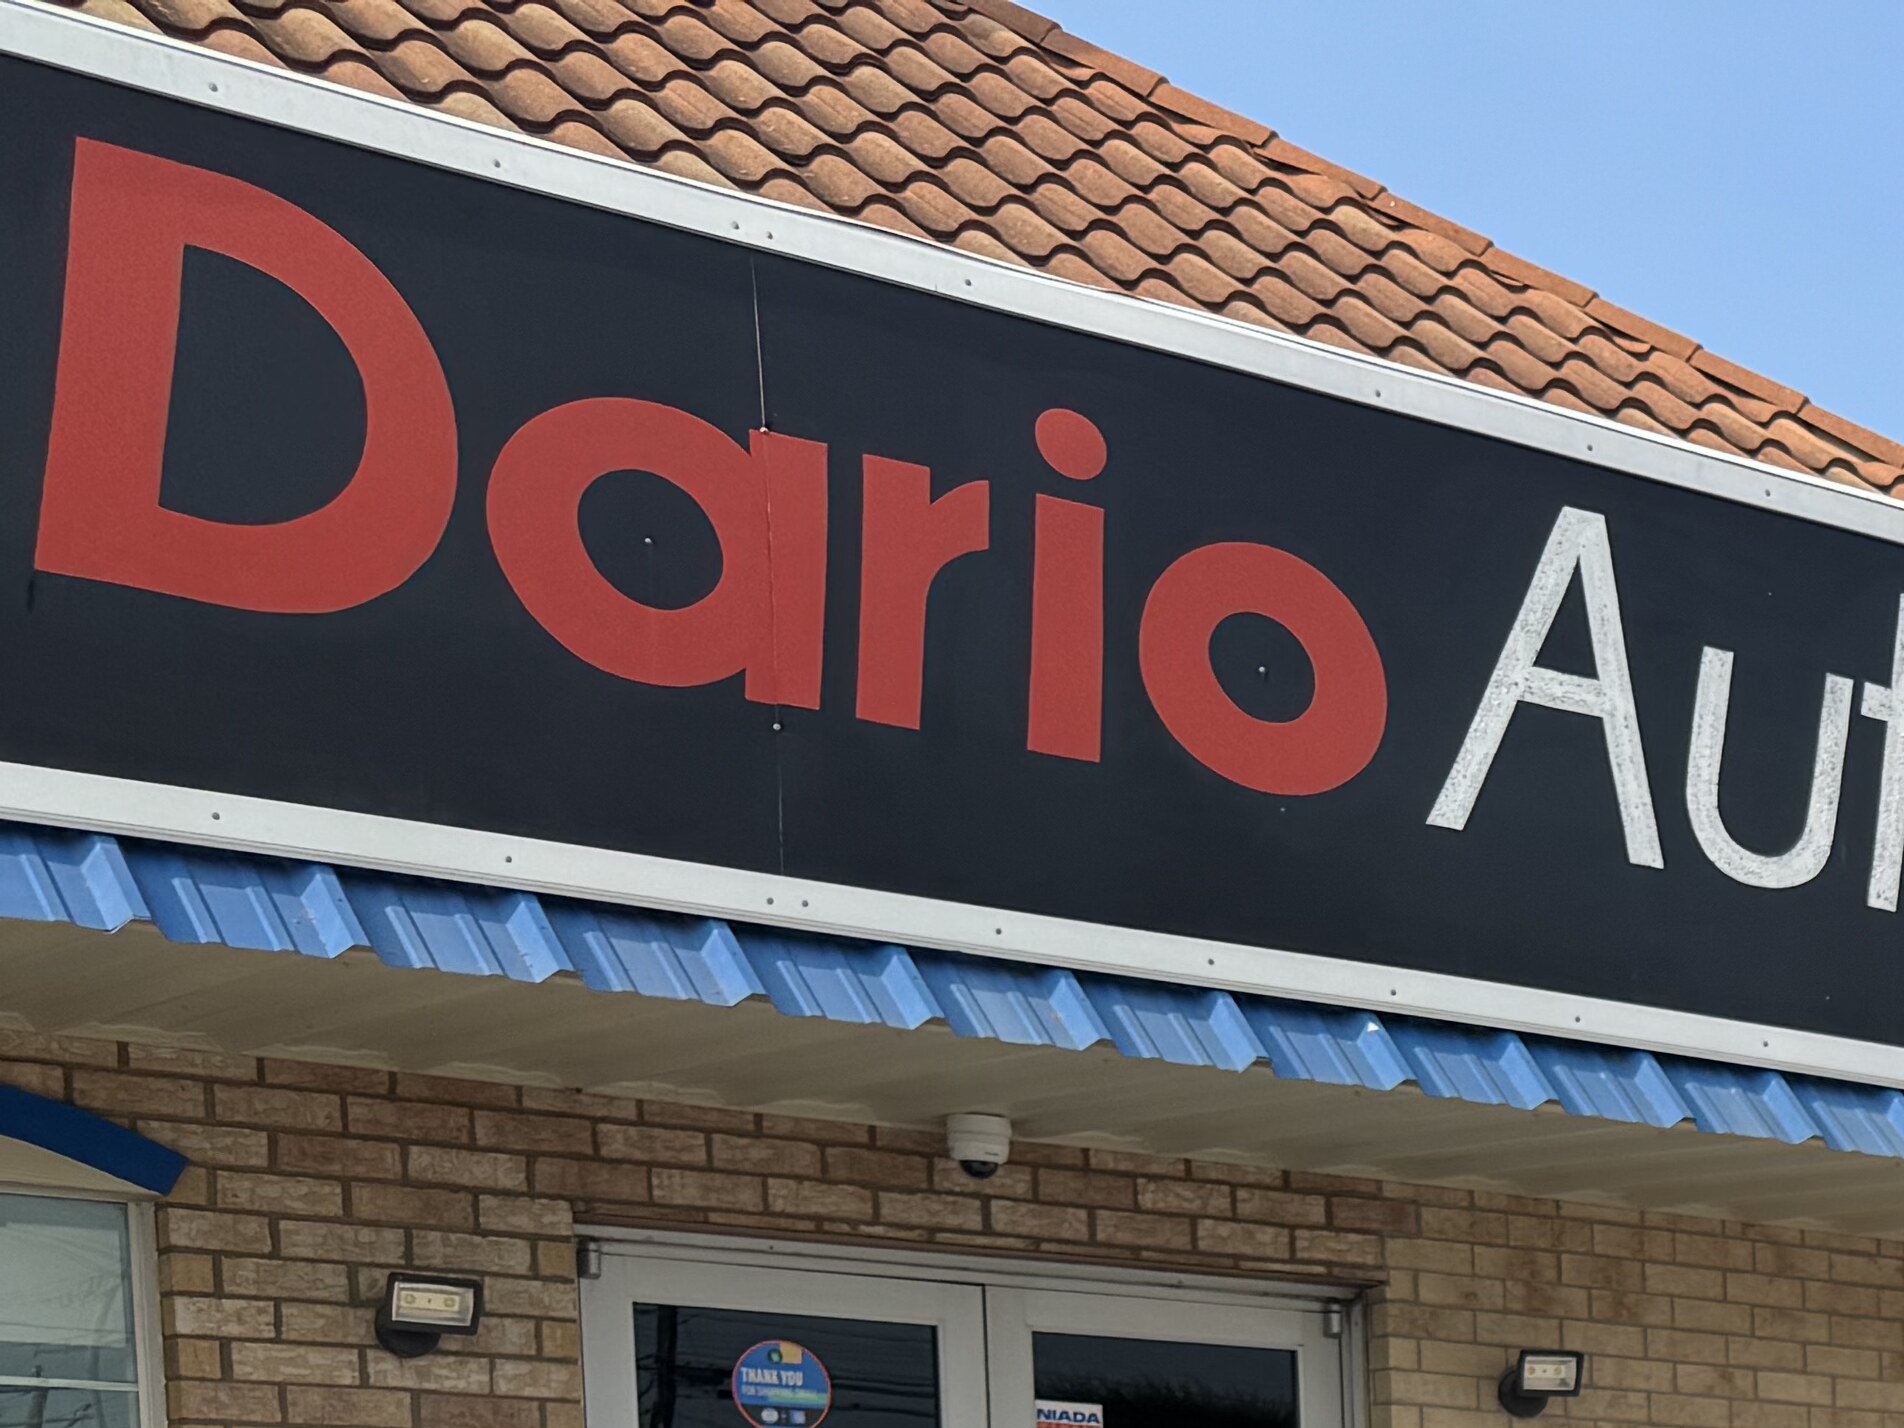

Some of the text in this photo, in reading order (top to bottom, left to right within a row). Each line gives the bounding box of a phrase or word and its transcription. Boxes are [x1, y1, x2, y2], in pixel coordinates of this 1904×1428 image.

[34, 135, 1388, 797] Dario
[741, 1367, 804, 1387] THANK YOU
[1036, 1408, 1101, 1424] NIADA
